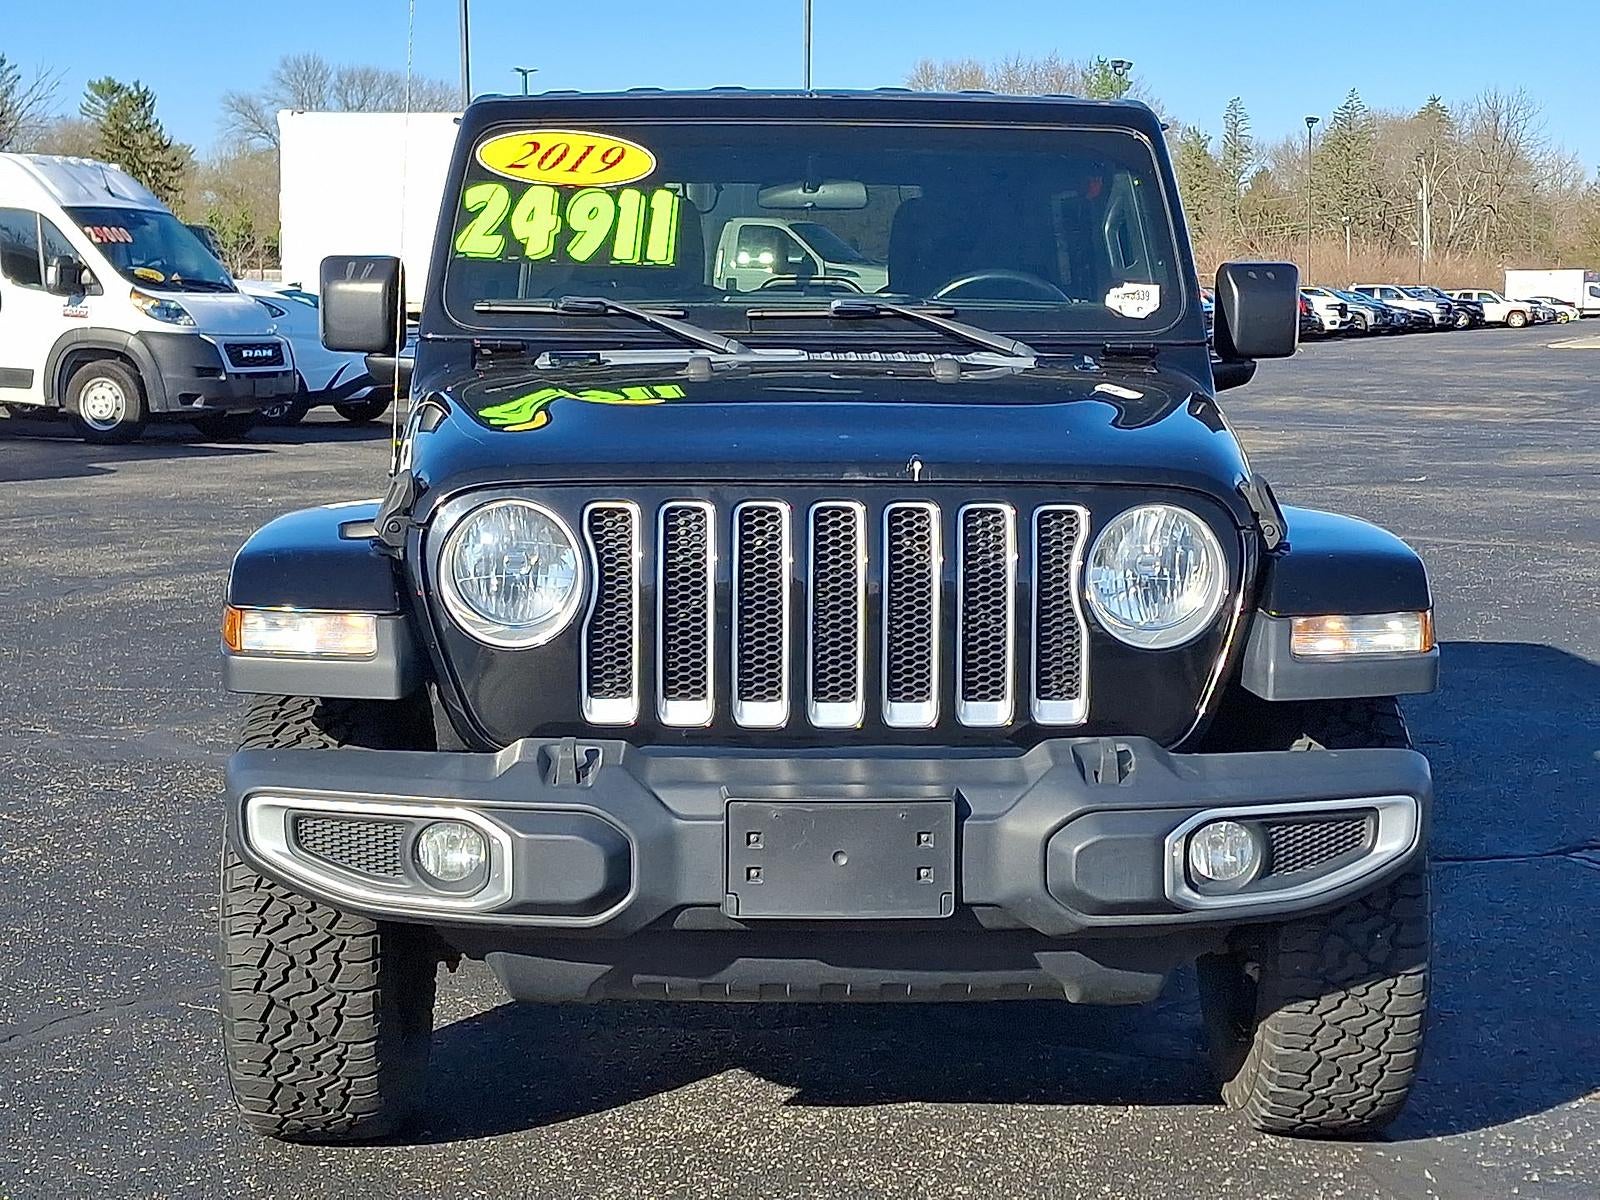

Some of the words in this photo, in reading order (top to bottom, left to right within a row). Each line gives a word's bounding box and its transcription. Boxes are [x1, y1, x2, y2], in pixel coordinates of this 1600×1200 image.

[506, 141, 626, 174] 2019
[455, 182, 680, 266] 24911
[242, 349, 273, 358] RAM
